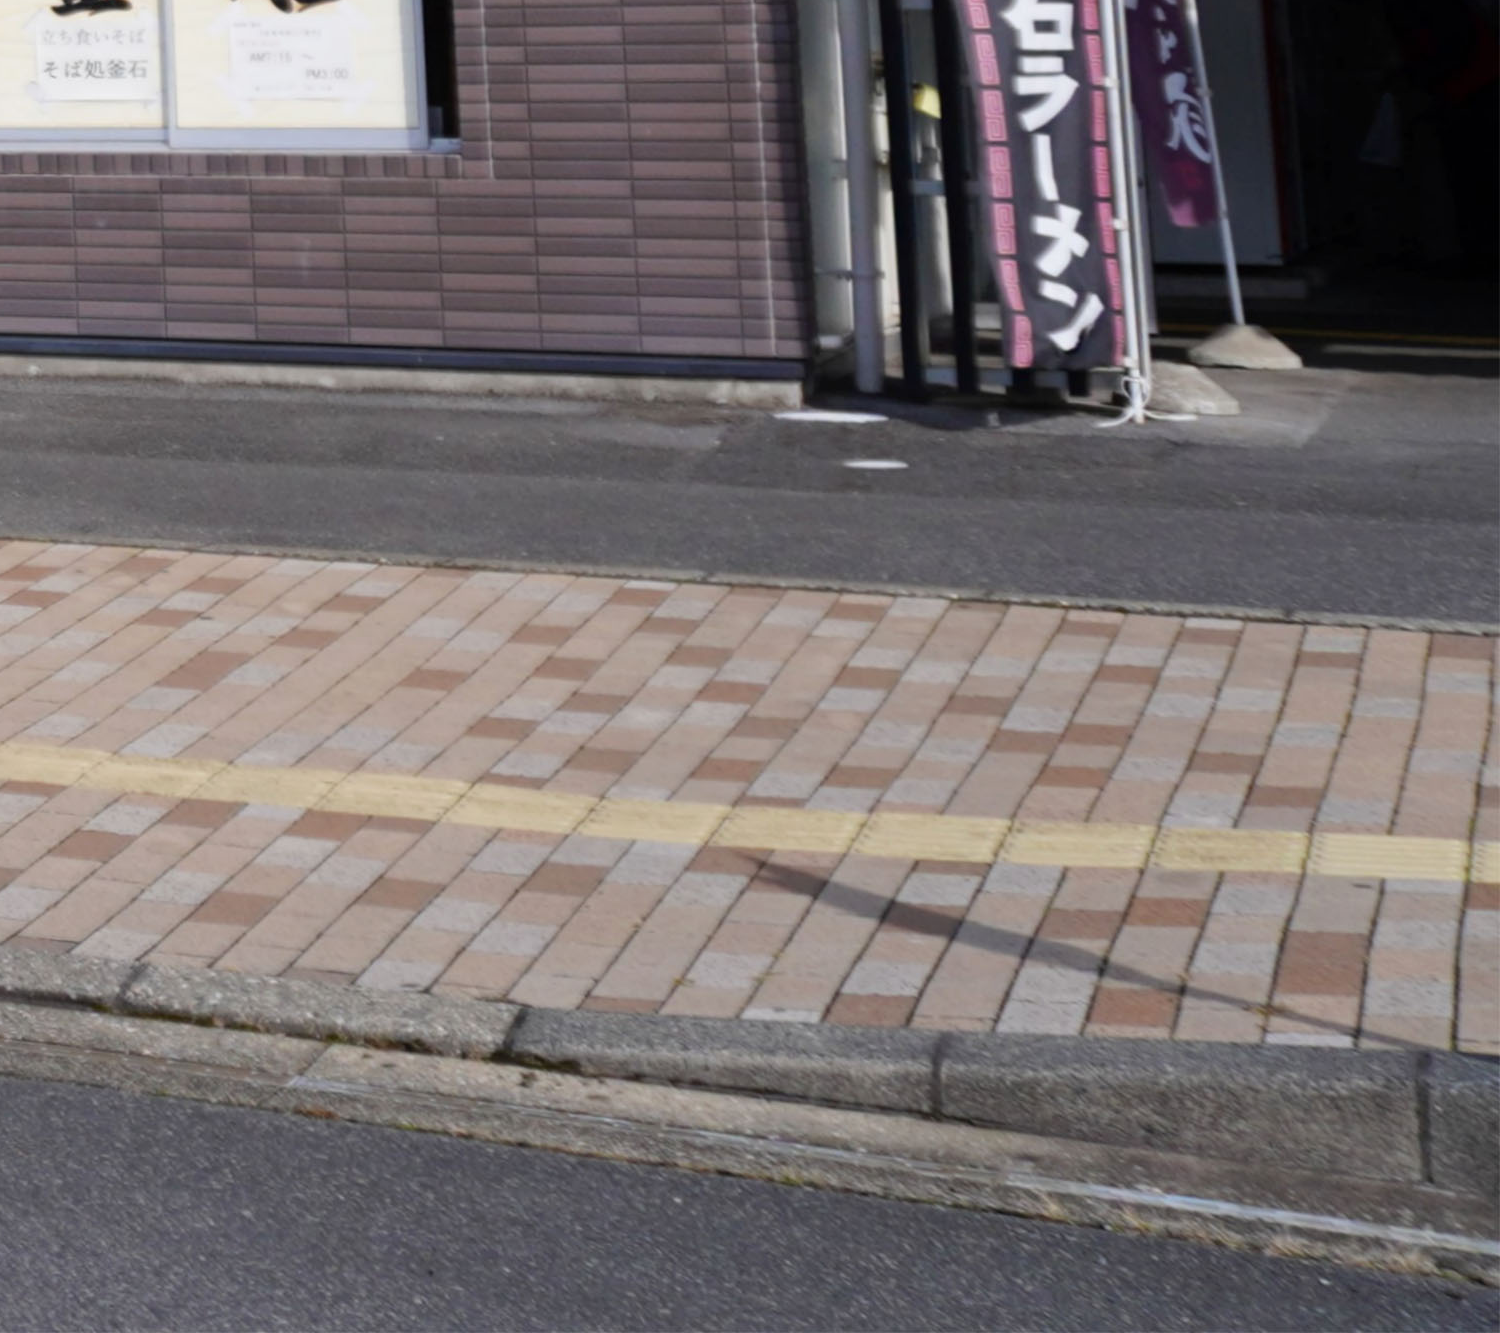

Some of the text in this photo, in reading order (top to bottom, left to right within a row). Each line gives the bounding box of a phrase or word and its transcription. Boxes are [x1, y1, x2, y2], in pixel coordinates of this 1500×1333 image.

[42, 28, 146, 46] 立ち食いそば
[43, 59, 149, 80] そば処釜石
